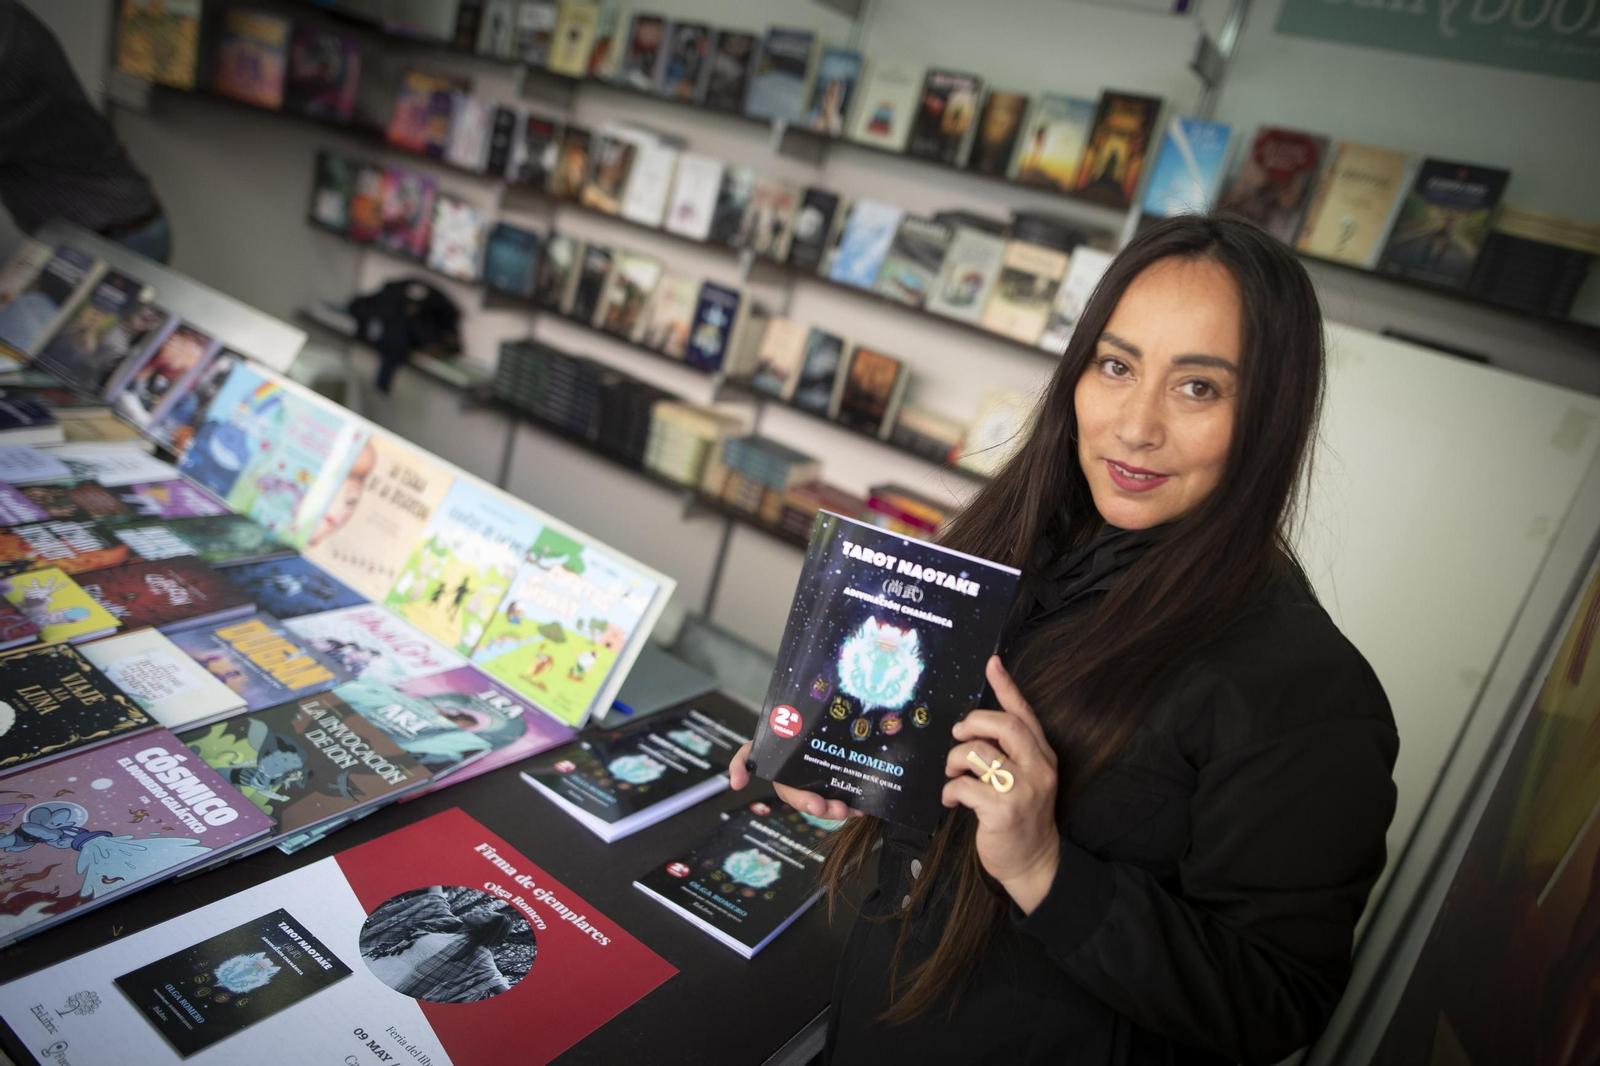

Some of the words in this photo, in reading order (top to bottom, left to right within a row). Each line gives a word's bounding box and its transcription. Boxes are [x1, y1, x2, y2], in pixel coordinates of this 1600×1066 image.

[842, 540, 897, 570] TAROT
[896, 559, 980, 597] NAOTAKE
[842, 586, 901, 611] ADIVINACIÓN
[900, 605, 953, 628] CHAMÁNICA
[16, 684, 61, 715] LUNA
[60, 672, 107, 706] VIAJE
[477, 690, 525, 719] IRA
[304, 729, 335, 750] DE
[377, 703, 432, 737] ARI
[301, 700, 328, 721] LA
[319, 715, 408, 785] INVOCACIÓN
[810, 738, 846, 759] OLGA
[848, 750, 904, 777] ROMERO
[135, 747, 239, 827] CÓSMICO
[803, 753, 831, 768] Ilustrado
[843, 766, 862, 778] DAVID
[879, 780, 902, 792] QUILES
[830, 777, 863, 797] ExLibric
[116, 757, 134, 768] EL
[125, 764, 169, 798] BOMBERO
[160, 796, 208, 834] GALÁCTICO
[474, 843, 518, 877] Firma
[514, 874, 536, 890] de
[532, 886, 612, 947] ejemplares
[483, 881, 513, 900] Olga
[511, 895, 547, 931] Romero
[278, 921, 302, 942] TAROT
[298, 939, 333, 971] NAOTAKE
[165, 983, 183, 1001] OLGA
[179, 998, 205, 1024] ROMERO
[353, 1027, 369, 1041] 09
[365, 1040, 393, 1062] MAY
[385, 1025, 408, 1047] Feria
[405, 1045, 422, 1058] del
[417, 1054, 434, 1066] lib
